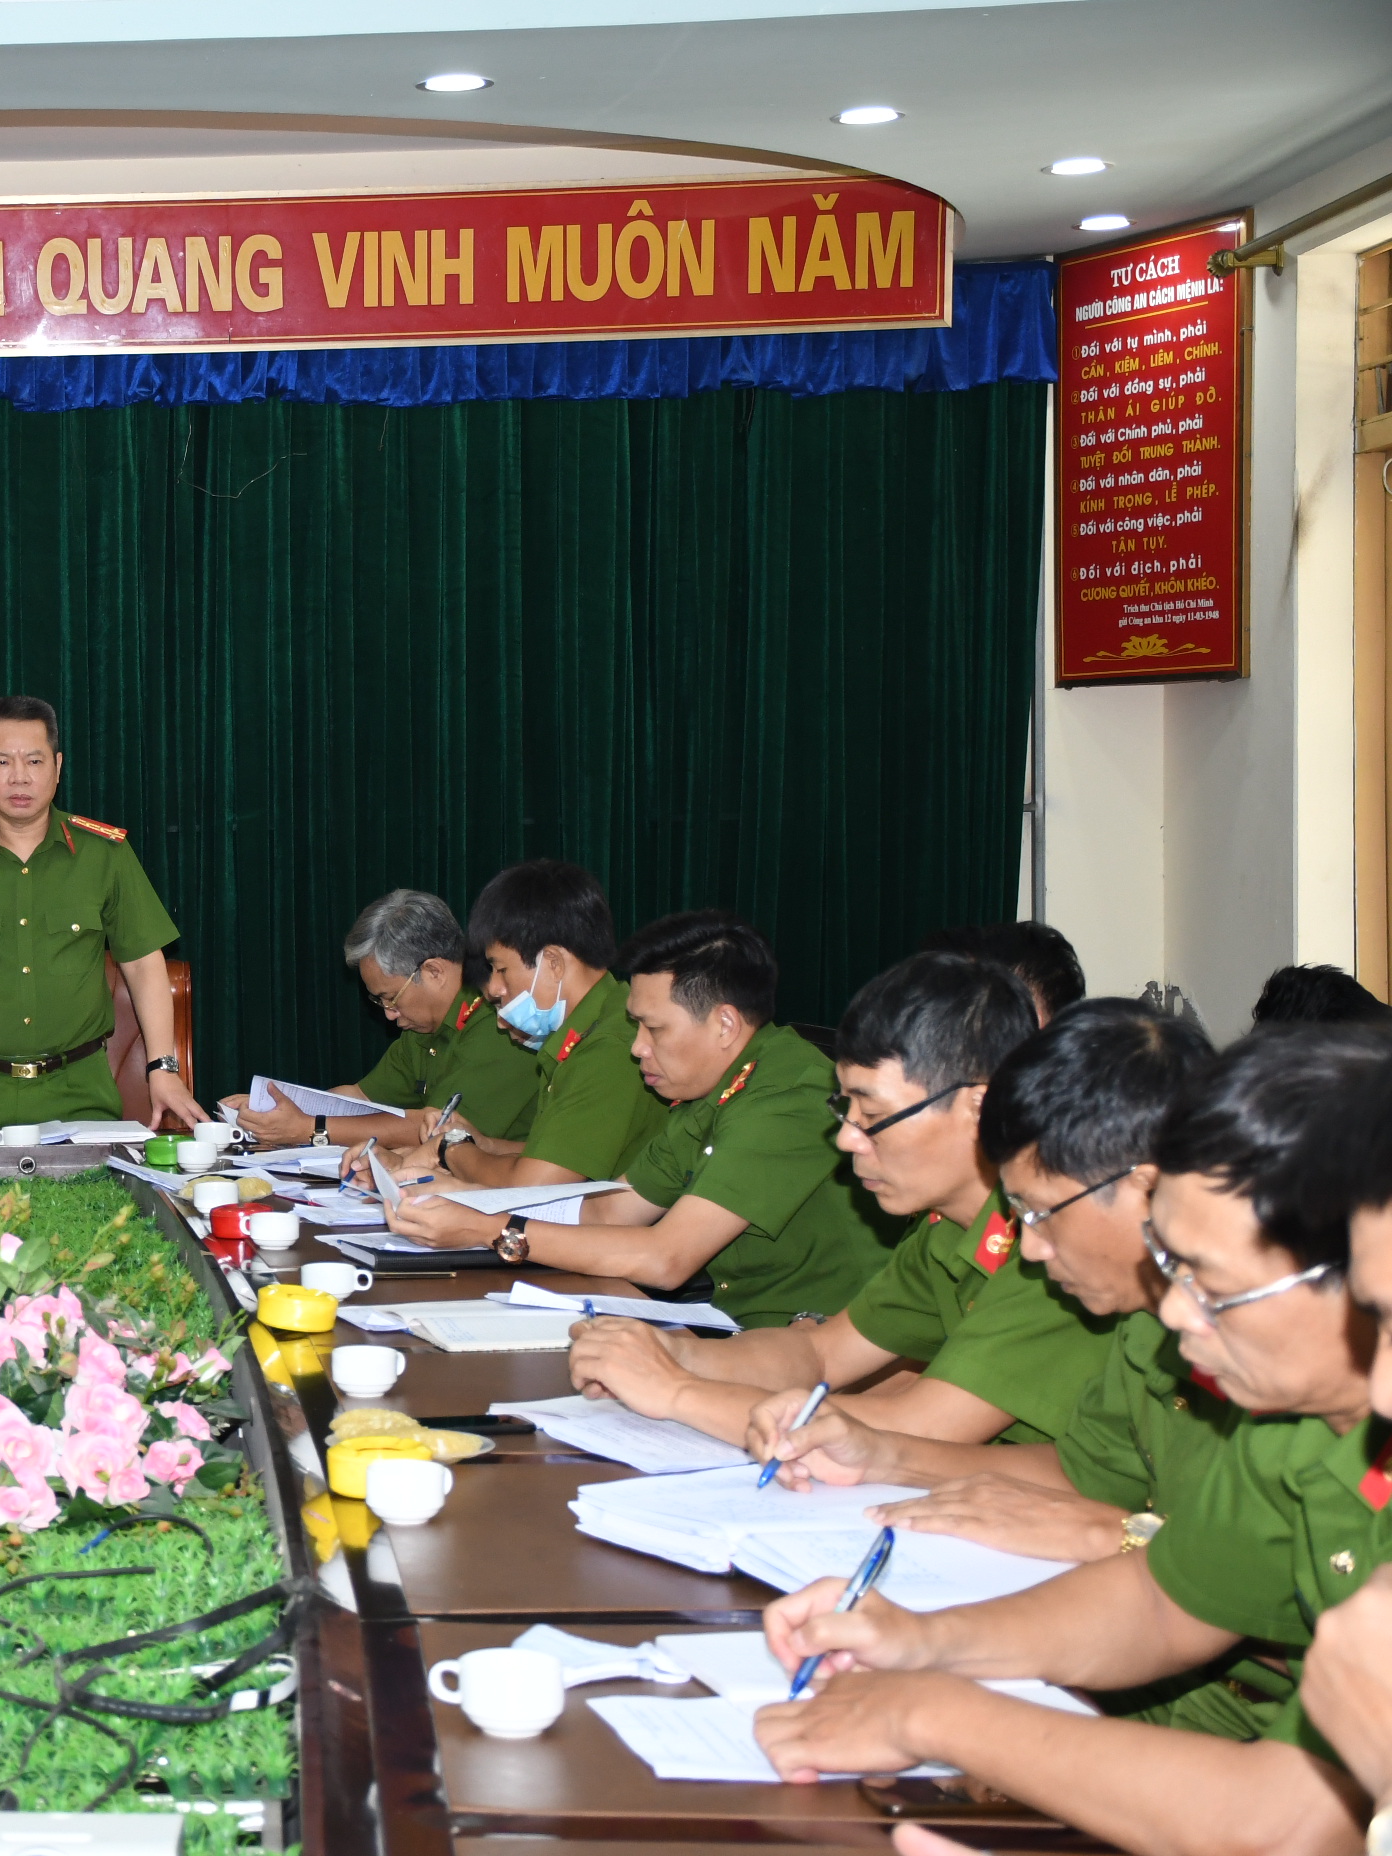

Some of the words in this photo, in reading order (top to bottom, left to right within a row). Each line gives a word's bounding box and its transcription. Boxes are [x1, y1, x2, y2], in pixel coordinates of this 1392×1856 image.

[36, 232, 283, 317] QUANG
[312, 229, 474, 308] VINH
[506, 199, 715, 303] MUÔN
[748, 194, 914, 293] NĂM
[1111, 263, 1133, 287] TƯ
[1135, 255, 1180, 282] CÁCH
[1076, 299, 1104, 322] NGƯỜI
[1106, 295, 1132, 315] CÔNG
[1133, 292, 1147, 310] AN
[1149, 285, 1175, 307] CÁCH
[1176, 278, 1205, 302] MỆNH
[1081, 340, 1099, 358] Đối
[1105, 337, 1122, 353] với
[1127, 336, 1138, 352] tự
[1144, 328, 1176, 346] mình,
[1180, 319, 1207, 342] phải
[1184, 340, 1222, 361] CHÍNH.
[1080, 386, 1098, 403] Đối
[1103, 383, 1120, 398] với
[1124, 378, 1154, 395] đồng
[1158, 376, 1176, 392] sự,
[1179, 366, 1205, 388] phải
[1081, 406, 1115, 424] THÂN
[1125, 399, 1140, 417] ÁI
[1150, 391, 1185, 413] GIÚP
[1080, 430, 1096, 447] Đối
[1100, 428, 1115, 444] với
[1118, 424, 1147, 441] Chính
[1151, 418, 1176, 439] phủ,
[1179, 413, 1203, 434] phải
[1080, 450, 1105, 470] TUYỆT
[1112, 444, 1132, 464] ĐỐI
[1140, 443, 1174, 459] TRUNG
[1182, 434, 1221, 453] THÀNH.
[1079, 475, 1095, 492] Đối
[1099, 473, 1115, 488] với
[1118, 470, 1144, 486] nhân
[1149, 467, 1174, 482] dân,
[1177, 460, 1202, 481] phải
[1080, 495, 1105, 513] KÍNH
[1165, 482, 1177, 502] LỄ
[1186, 479, 1219, 499] PHÉP.
[1080, 519, 1096, 536] Đối
[1099, 518, 1114, 533] với
[1117, 517, 1144, 532] công
[1177, 506, 1202, 527] phải
[1112, 536, 1135, 557] TẬN
[1143, 535, 1167, 554] TỤY.
[1079, 563, 1100, 580] Đối
[1105, 562, 1125, 577] với
[1131, 560, 1166, 577] địch,
[1170, 553, 1201, 573] phải
[1080, 586, 1117, 601] CƯƠNG
[1155, 576, 1185, 595] KHÔN
[1187, 572, 1219, 592] KHÉO.
[1123, 604, 1139, 613] Trích
[1197, 598, 1214, 607] Minh
[1165, 614, 1171, 623] 12
